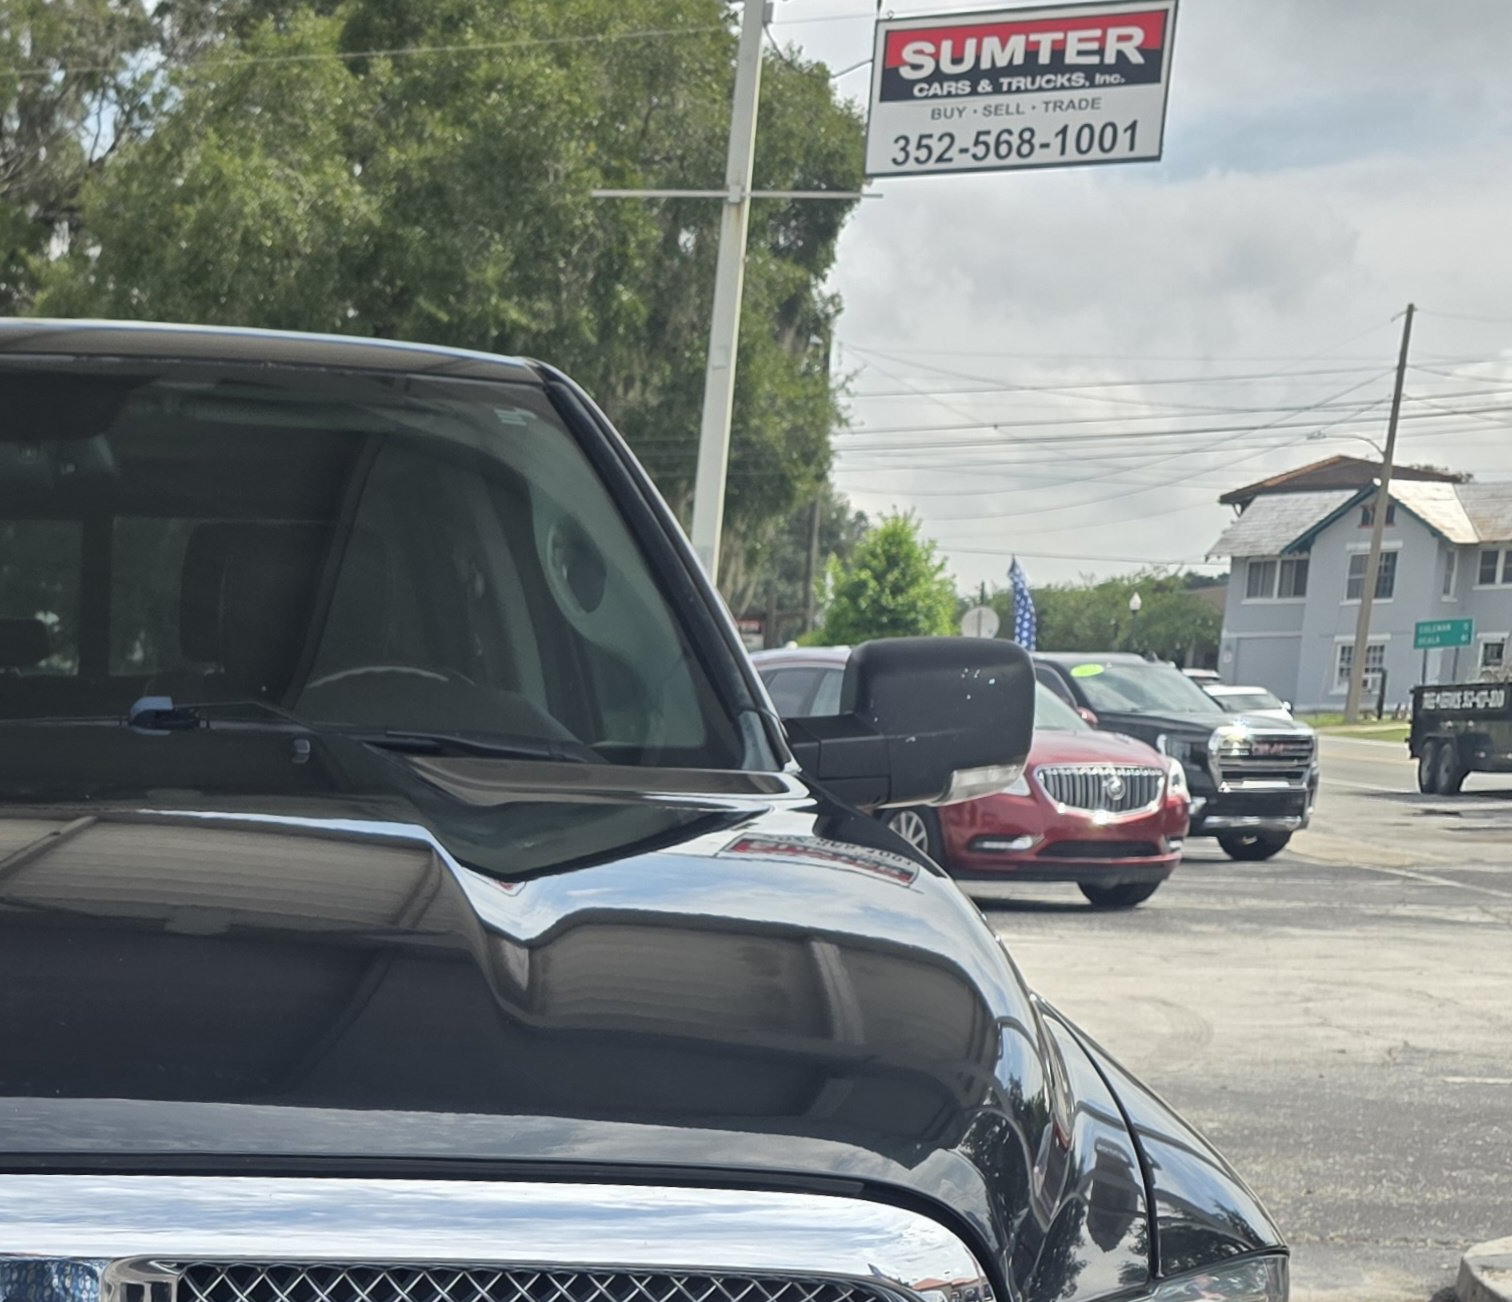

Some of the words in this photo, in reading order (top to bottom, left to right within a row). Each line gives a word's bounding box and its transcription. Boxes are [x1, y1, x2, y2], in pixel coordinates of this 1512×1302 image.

[898, 25, 1146, 80] SUMTER
[912, 79, 972, 98] CARS
[977, 79, 993, 94] &
[930, 105, 967, 121] BUY
[982, 103, 1026, 118] SELL
[1042, 97, 1103, 113] TRADE
[890, 119, 1140, 167] 352-568-1001
